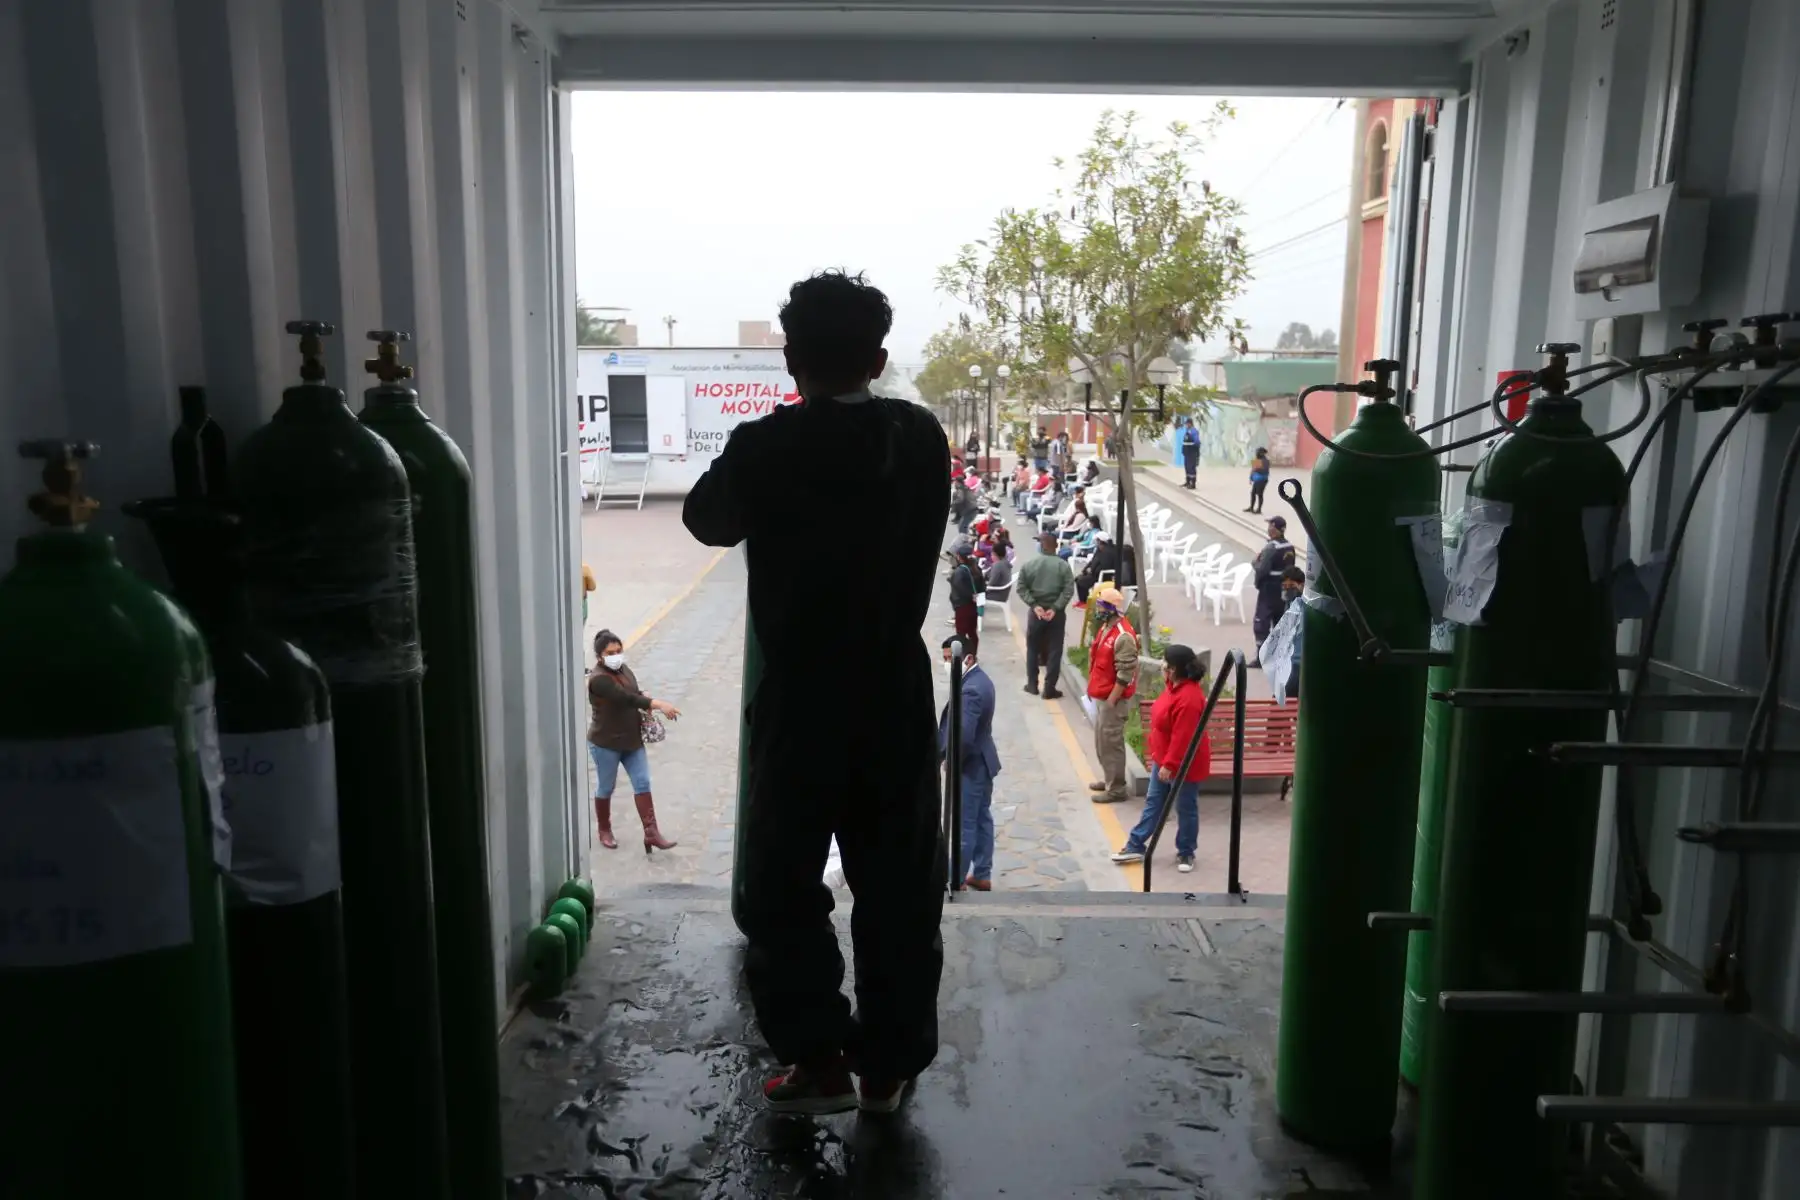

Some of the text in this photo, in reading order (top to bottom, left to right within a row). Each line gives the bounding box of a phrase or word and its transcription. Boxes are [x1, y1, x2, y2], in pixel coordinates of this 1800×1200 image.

[694, 382, 782, 398] HOSPITAL
[686, 427, 724, 440] lvaro
[694, 441, 712, 452] De
